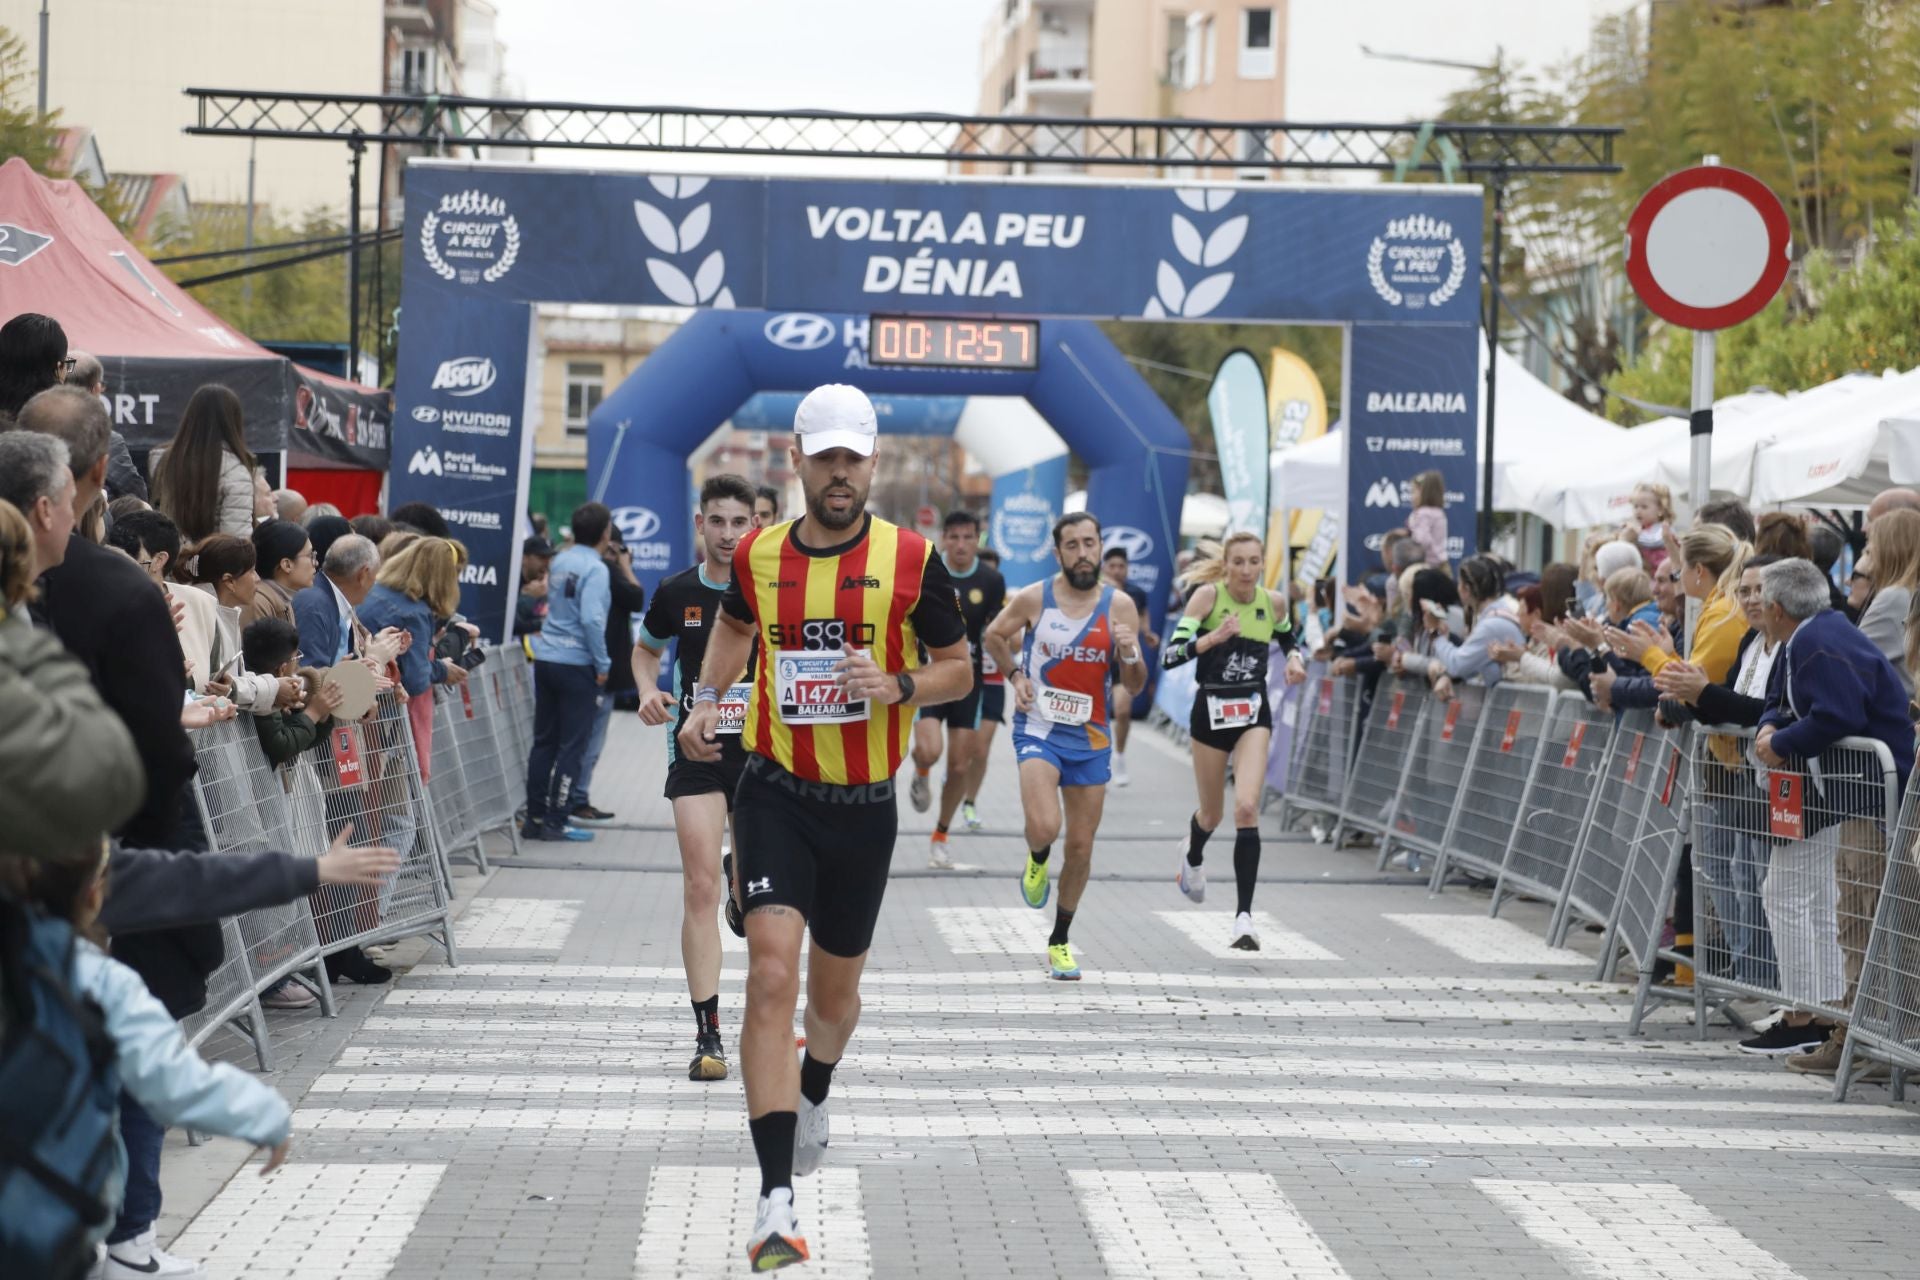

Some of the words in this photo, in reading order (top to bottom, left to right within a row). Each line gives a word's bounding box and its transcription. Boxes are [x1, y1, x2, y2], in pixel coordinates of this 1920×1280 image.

[442, 221, 500, 235] CIRCUIT
[807, 206, 947, 243] VOLTA
[951, 212, 986, 244] A
[995, 213, 1085, 247] PEU
[448, 235, 459, 247] A
[463, 236, 492, 248] PEU
[1388, 246, 1446, 260] CIRCUIT
[863, 247, 1023, 298] DÉNIA
[1394, 260, 1406, 272] A
[1408, 260, 1438, 272] PEU
[880, 320, 1029, 362] 00:12:57
[432, 358, 491, 389] Asevi
[1366, 391, 1466, 413] BALEARIA
[443, 409, 511, 428] HYUNDAI
[1386, 438, 1463, 453] masymas
[444, 451, 476, 464] Portal
[437, 508, 501, 525] asymas
[784, 687, 794, 702] A
[799, 685, 843, 703] 1477
[720, 706, 742, 719] 468
[797, 705, 847, 715] BALEARIA
[1050, 698, 1078, 714] 3701
[766, 768, 893, 804] ARMO
